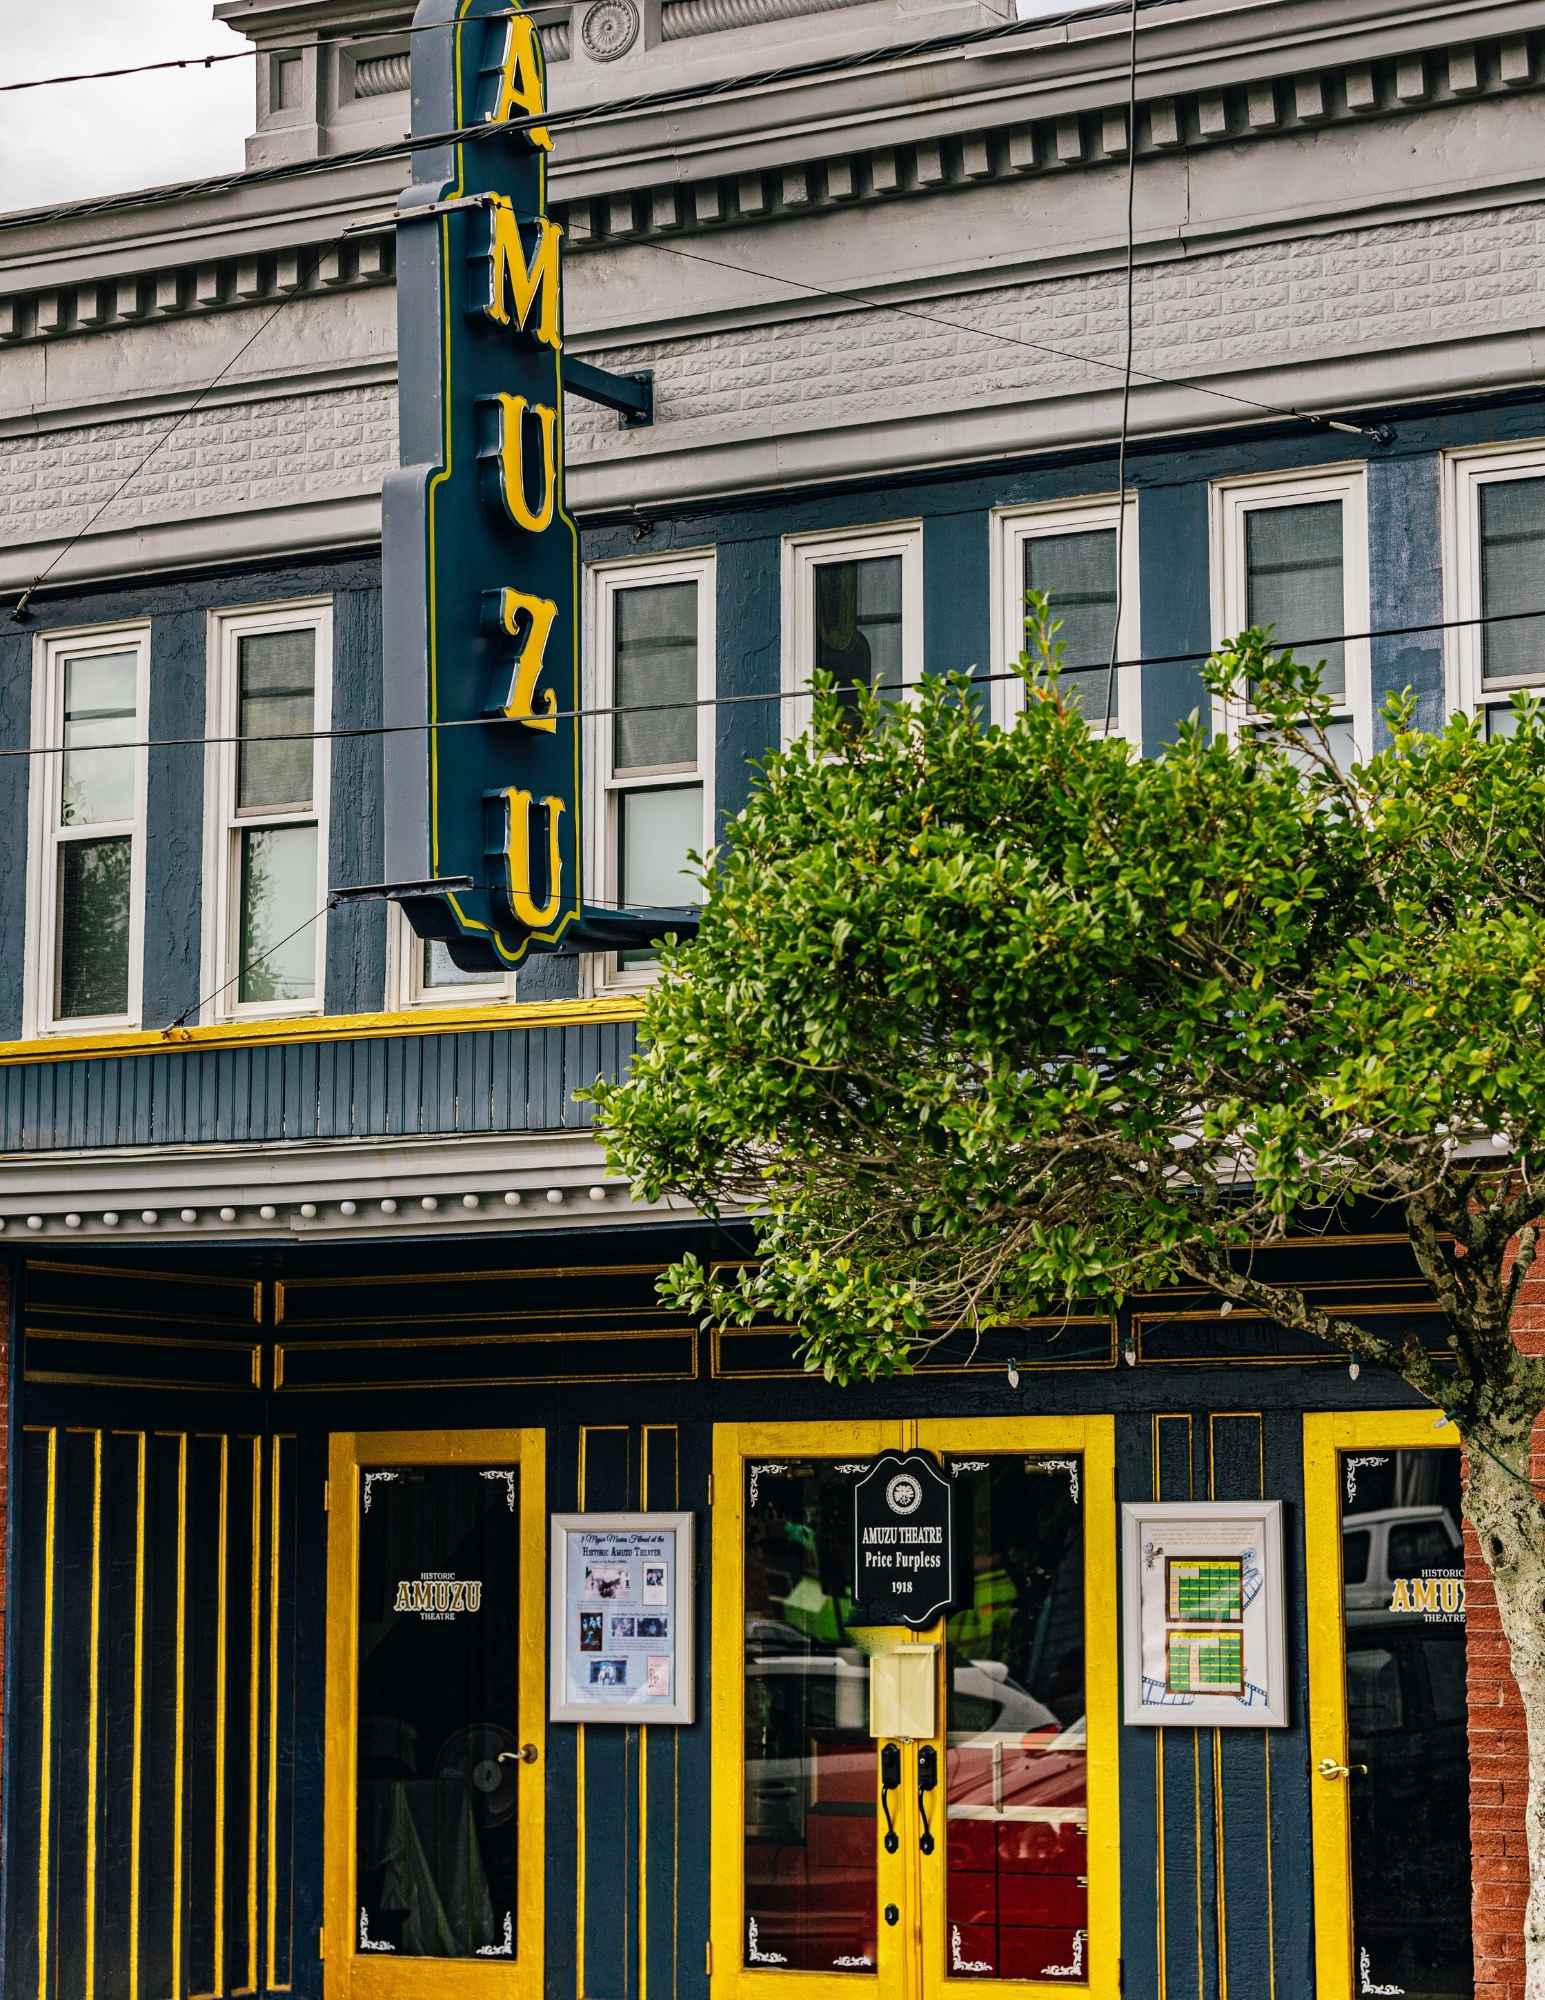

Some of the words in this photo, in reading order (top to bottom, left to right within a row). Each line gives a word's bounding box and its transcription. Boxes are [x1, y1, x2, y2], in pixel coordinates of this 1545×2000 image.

[484, 9, 566, 928] AMUZU
[862, 1526, 898, 1544] AMUZU
[898, 1526, 943, 1544] THEATRE
[865, 1550, 893, 1568] Price
[895, 1550, 941, 1573] Furpless
[420, 1572, 456, 1580] HISTORIC
[1421, 1568, 1465, 1578] HISTORIC
[891, 1581, 913, 1594] 1918
[393, 1581, 482, 1612] AMUZU
[420, 1612, 456, 1620] THEATRE
[1423, 1613, 1466, 1623] THEATRE
